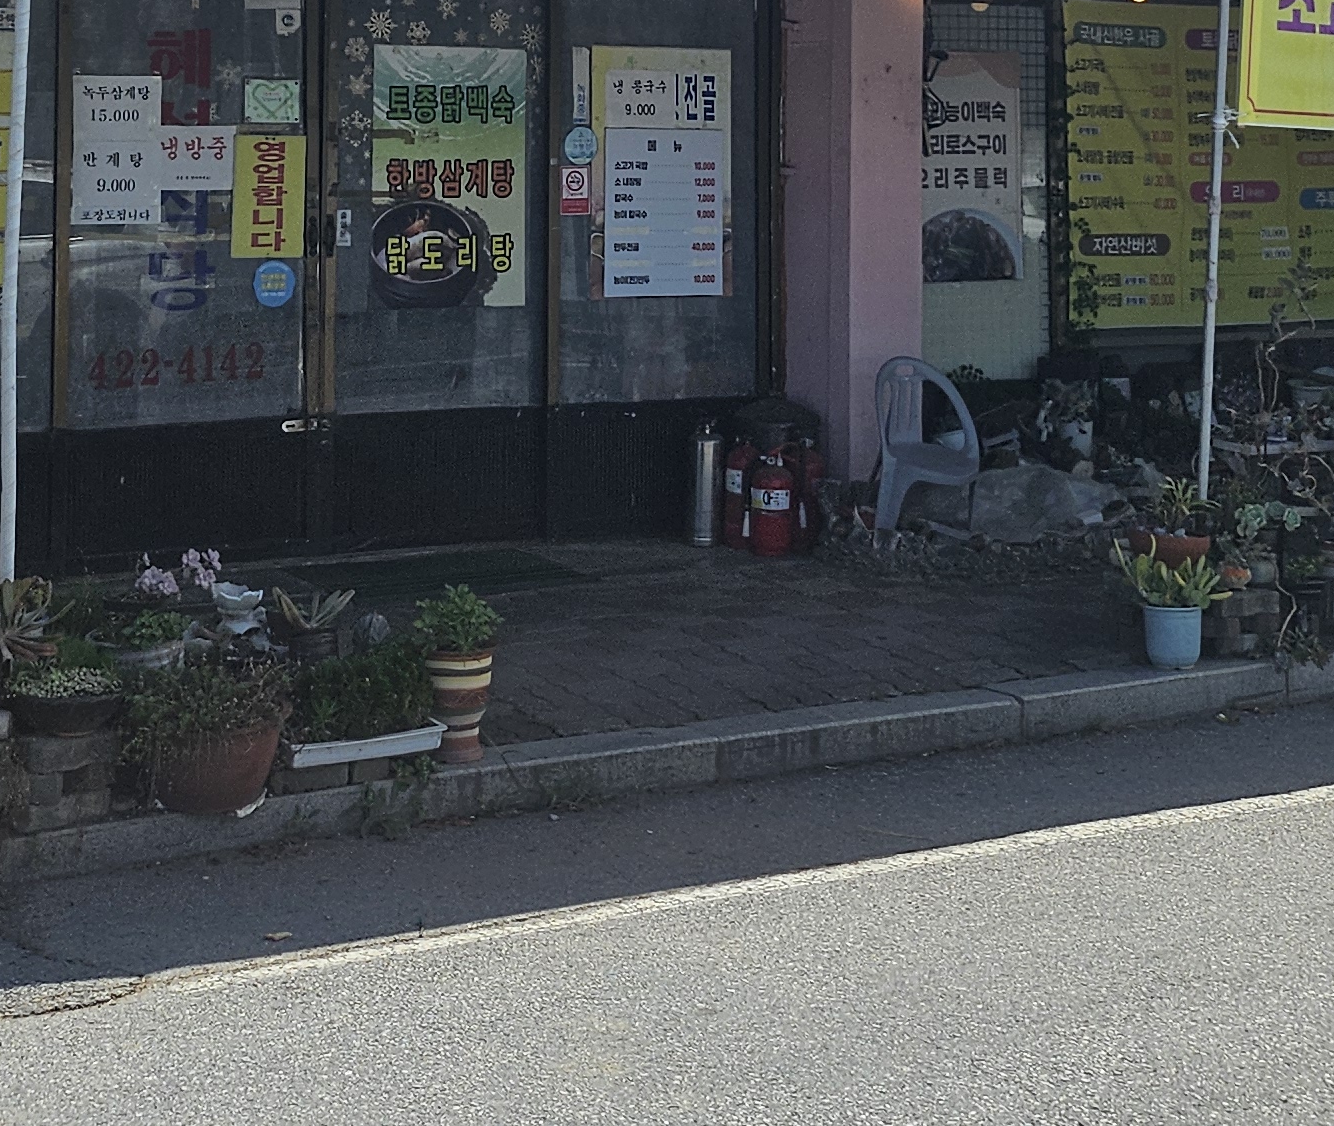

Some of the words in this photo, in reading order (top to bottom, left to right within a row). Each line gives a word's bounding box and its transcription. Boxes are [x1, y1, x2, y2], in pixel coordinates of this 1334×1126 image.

[90, 109, 139, 122] 15.000
[386, 84, 515, 124] 토종닭백숙
[625, 104, 655, 115] 9.000
[929, 101, 1006, 122] 능이백숙
[161, 136, 227, 160] 냉방중
[97, 179, 135, 192] 9.000
[387, 159, 515, 198] 한방삼계탕
[251, 142, 288, 251] 영업합니다
[386, 233, 514, 274] 닭도리탕
[1093, 237, 1157, 254] 자연산버섯
[92, 342, 264, 390] 422-4142
